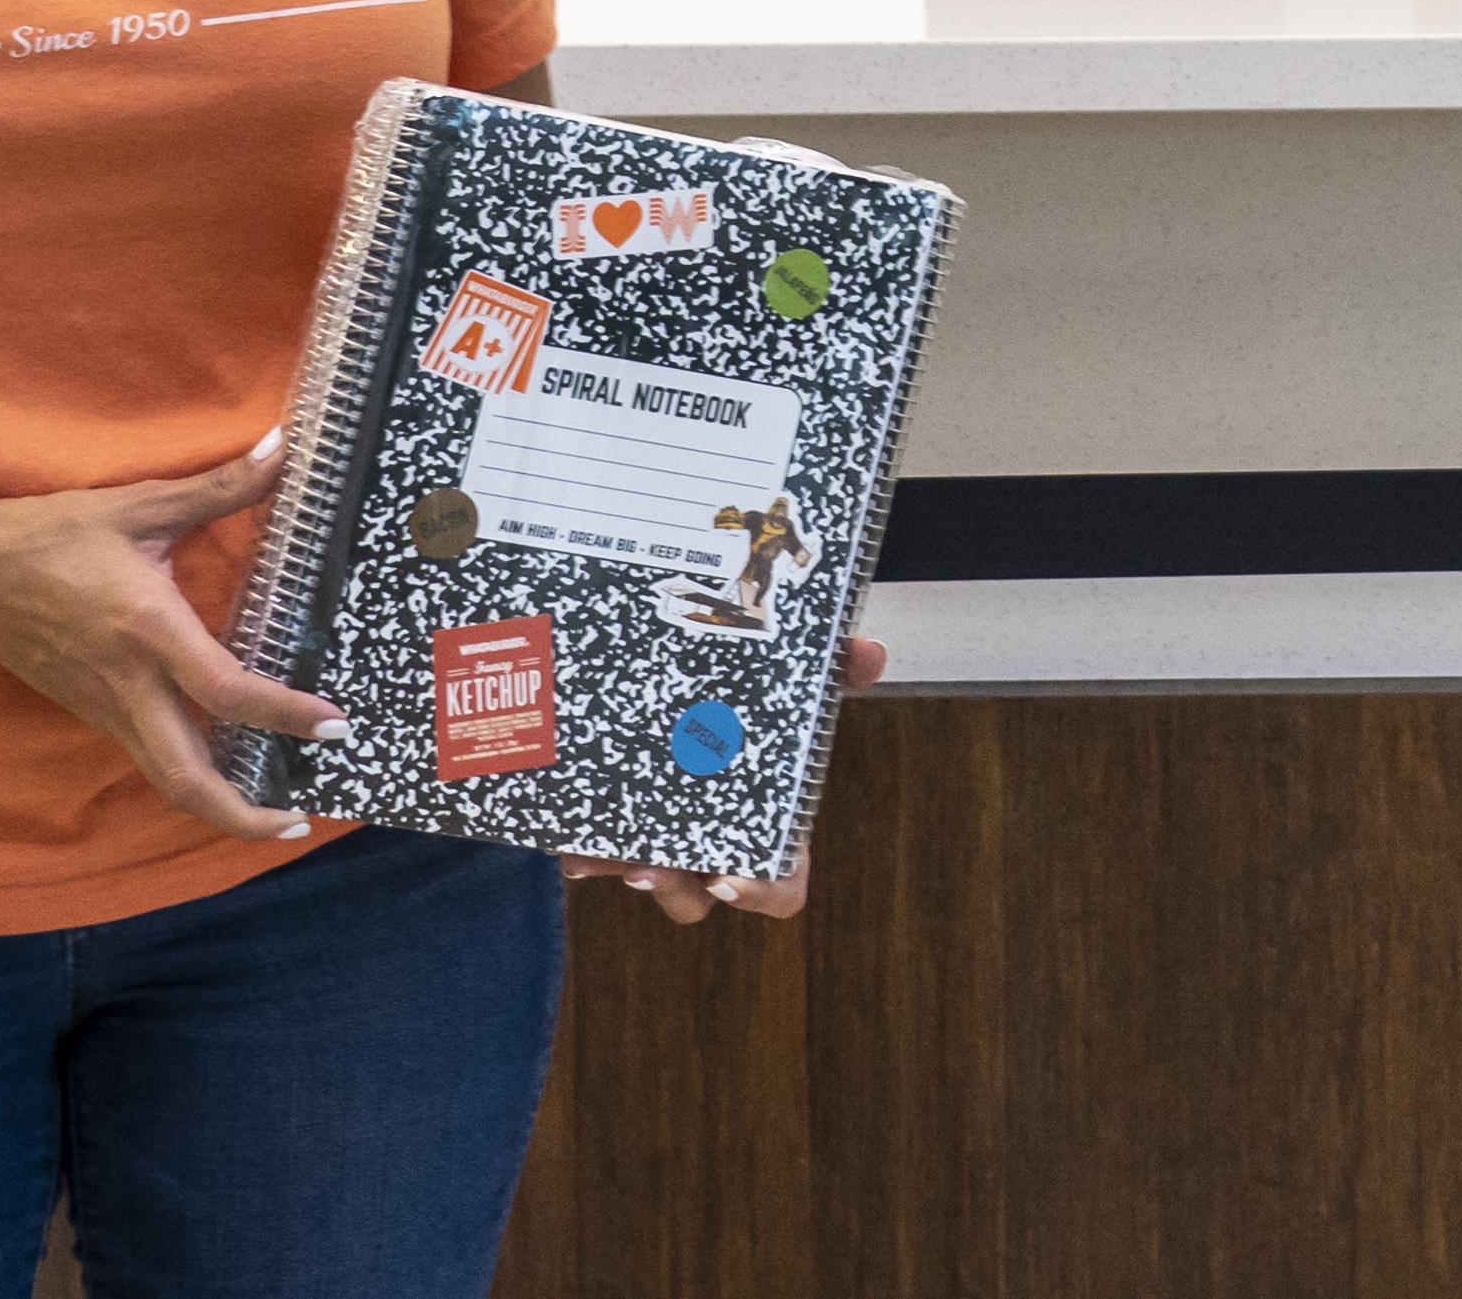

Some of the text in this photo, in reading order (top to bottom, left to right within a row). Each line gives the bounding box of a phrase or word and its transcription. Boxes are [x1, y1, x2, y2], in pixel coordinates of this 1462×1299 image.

[10, 9, 191, 58] Since 1950
[450, 320, 503, 360] A+
[541, 367, 752, 429] SPIRAL NOTEBOOK
[498, 518, 723, 568] AIM HIGH DREAM BIG KEEP GOING
[445, 670, 542, 717] KETCHUP
